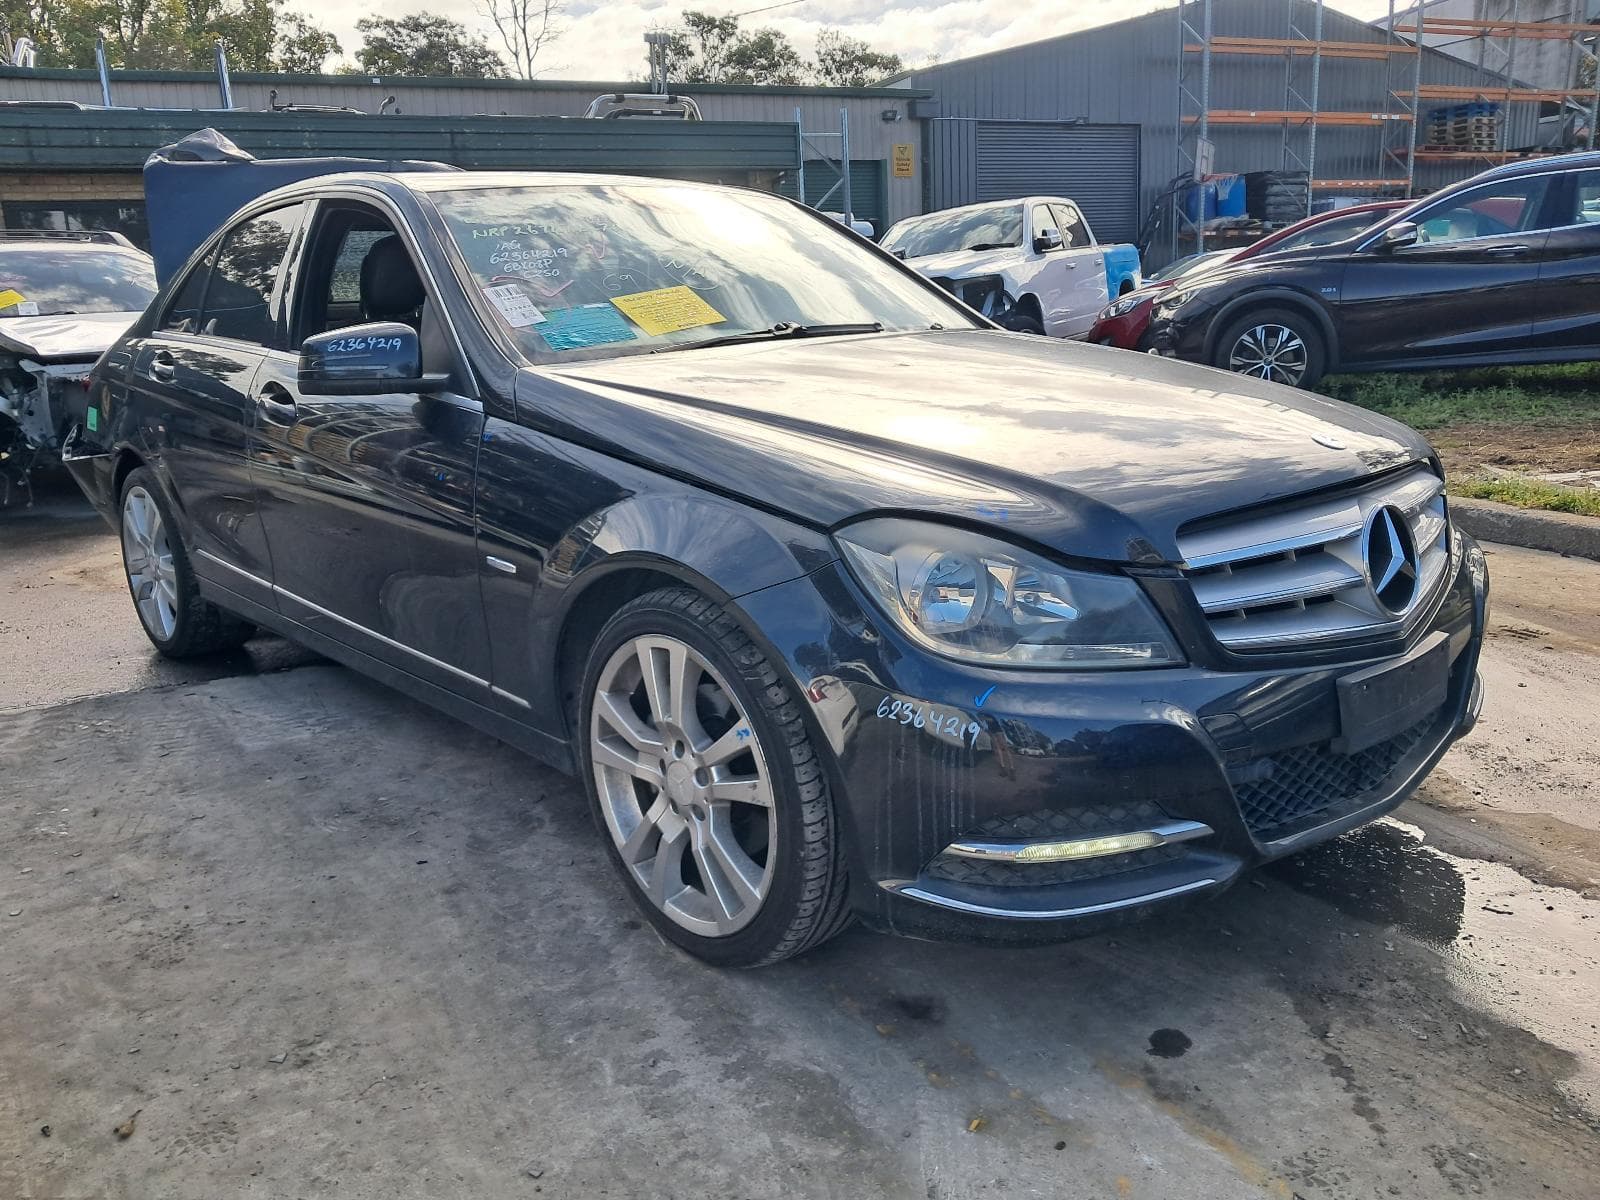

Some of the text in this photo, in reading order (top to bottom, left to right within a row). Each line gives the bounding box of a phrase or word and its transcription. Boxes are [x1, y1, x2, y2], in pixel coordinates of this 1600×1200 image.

[489, 247, 569, 264] 62364219
[327, 336, 402, 352] 62364219
[876, 695, 981, 748] 62364219
